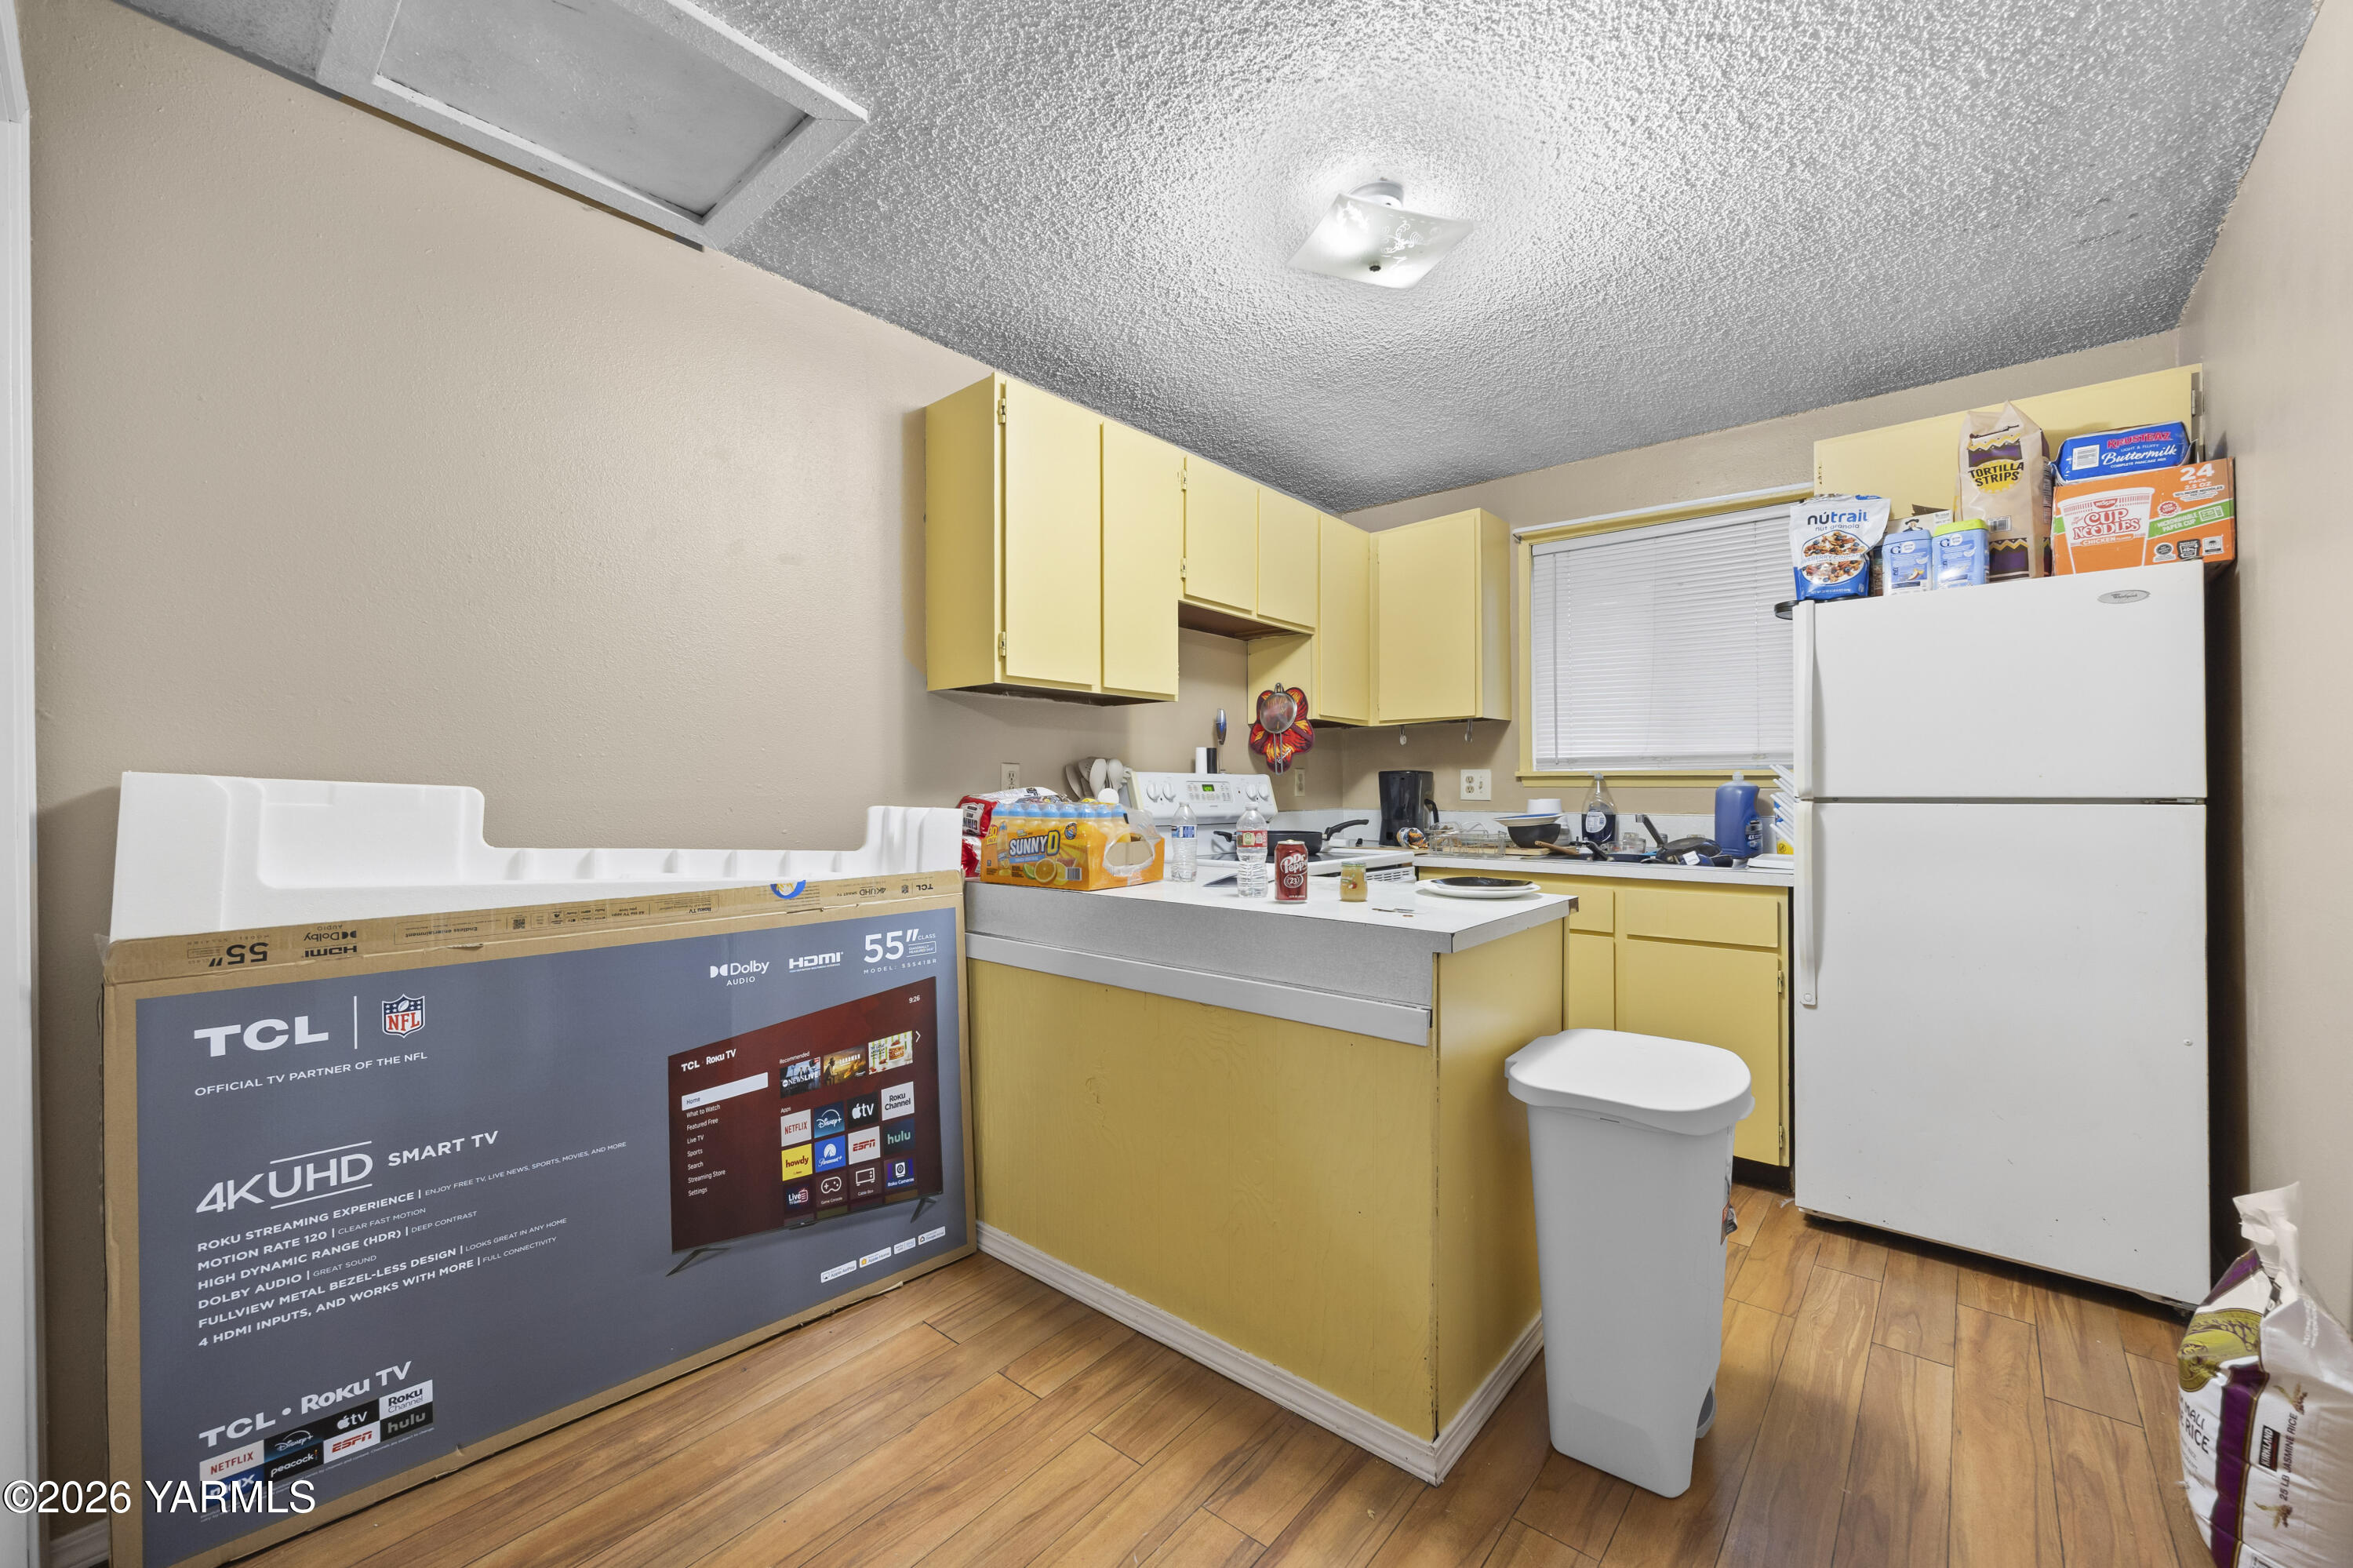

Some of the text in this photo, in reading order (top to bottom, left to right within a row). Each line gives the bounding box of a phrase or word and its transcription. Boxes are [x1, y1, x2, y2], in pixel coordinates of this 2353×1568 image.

[2107, 431, 2173, 449] KRUSTEAZ
[2101, 444, 2177, 465] Buttermilk
[1968, 461, 2024, 478] TORTILLA
[2180, 463, 2215, 482] 24
[1975, 471, 2020, 487] STRIPS
[2084, 508, 2129, 527] CUP
[2073, 518, 2140, 540] NOODLES
[2162, 522, 2184, 532] PAPER
[2082, 537, 2116, 545] CHICKEN
[1293, 853, 1306, 864] Dr
[304, 931, 340, 942] Dolby
[304, 945, 357, 958] HDMI
[730, 960, 770, 977] Dolby
[789, 952, 841, 970] HDMI
[726, 977, 755, 986] AUDIO
[194, 1010, 420, 1057] TCL NFL
[681, 1049, 736, 1072] TCL Roku TV
[779, 1051, 810, 1064] Recommended
[195, 1052, 428, 1097] OFFICIAL TV PARTNER OF THE NFL
[804, 1071, 819, 1082] LIVE
[686, 1097, 700, 1105] Home
[885, 1098, 911, 1111] Channel
[889, 1093, 906, 1102] Roku
[686, 1108, 699, 1118] What
[705, 1104, 721, 1114] Watch
[862, 1103, 875, 1116] tv
[686, 1121, 707, 1130] Featured
[784, 1121, 808, 1135] NETFLIX
[853, 1139, 876, 1151] ESPN
[887, 1131, 911, 1144] hulu
[387, 1138, 465, 1167] SMART
[471, 1130, 498, 1148] TV
[687, 1148, 704, 1158] Sports
[687, 1161, 704, 1170] Search
[785, 1155, 809, 1168] howdy
[688, 1169, 726, 1184] Streaming Store
[198, 1234, 241, 1253] ROKU
[245, 1213, 329, 1240] STREAMING
[333, 1191, 414, 1219] EXPERIENCE
[425, 1184, 452, 1196] ENJOY
[453, 1178, 474, 1189] FREE
[488, 1171, 505, 1180] LIVE
[507, 1166, 530, 1176] NEWS,
[531, 1158, 561, 1170] SPORTS,
[562, 1151, 589, 1162] MOVIES,
[591, 1146, 606, 1155] AND
[607, 1141, 627, 1151] MORE
[688, 1187, 707, 1197] Settings
[788, 1192, 801, 1202] Live
[198, 1208, 426, 1271] MOTION RATE 120 CLEAR FAST MOTION
[198, 1210, 477, 1290] HIGH DYNAMIC RANGE (HDR) DEEP CONTRAST
[198, 1299, 275, 1329] FULLVIEW
[279, 1286, 325, 1305] METAL
[329, 1262, 407, 1291] BEZEL-LESS
[411, 1248, 456, 1268] DESIGN
[466, 1239, 492, 1252] LOOKS
[493, 1231, 518, 1243] GREAT
[529, 1224, 544, 1233] ANY
[546, 1217, 568, 1228] HOME
[198, 1254, 377, 1309] DOLBY AUDIO GREAT SOUND
[198, 1236, 557, 1347] 4 HDMI INPUTS, AND WORKS WITH MORE FULL CONNECTIVITY
[198, 1360, 412, 1448] TCL Roku TV
[387, 1388, 424, 1406] Roku
[387, 1395, 424, 1413] Channel
[351, 1411, 368, 1426] tv
[387, 1412, 426, 1433] hulu
[332, 1431, 373, 1453] ESPN
[2185, 1418, 2210, 1454] RICE
[2261, 1427, 2274, 1468] KIRKLAND
[210, 1451, 254, 1475] NETFLIX
[2279, 1413, 2298, 1501] 25 LB JASMINE RICE
[271, 1453, 315, 1479] peacock
